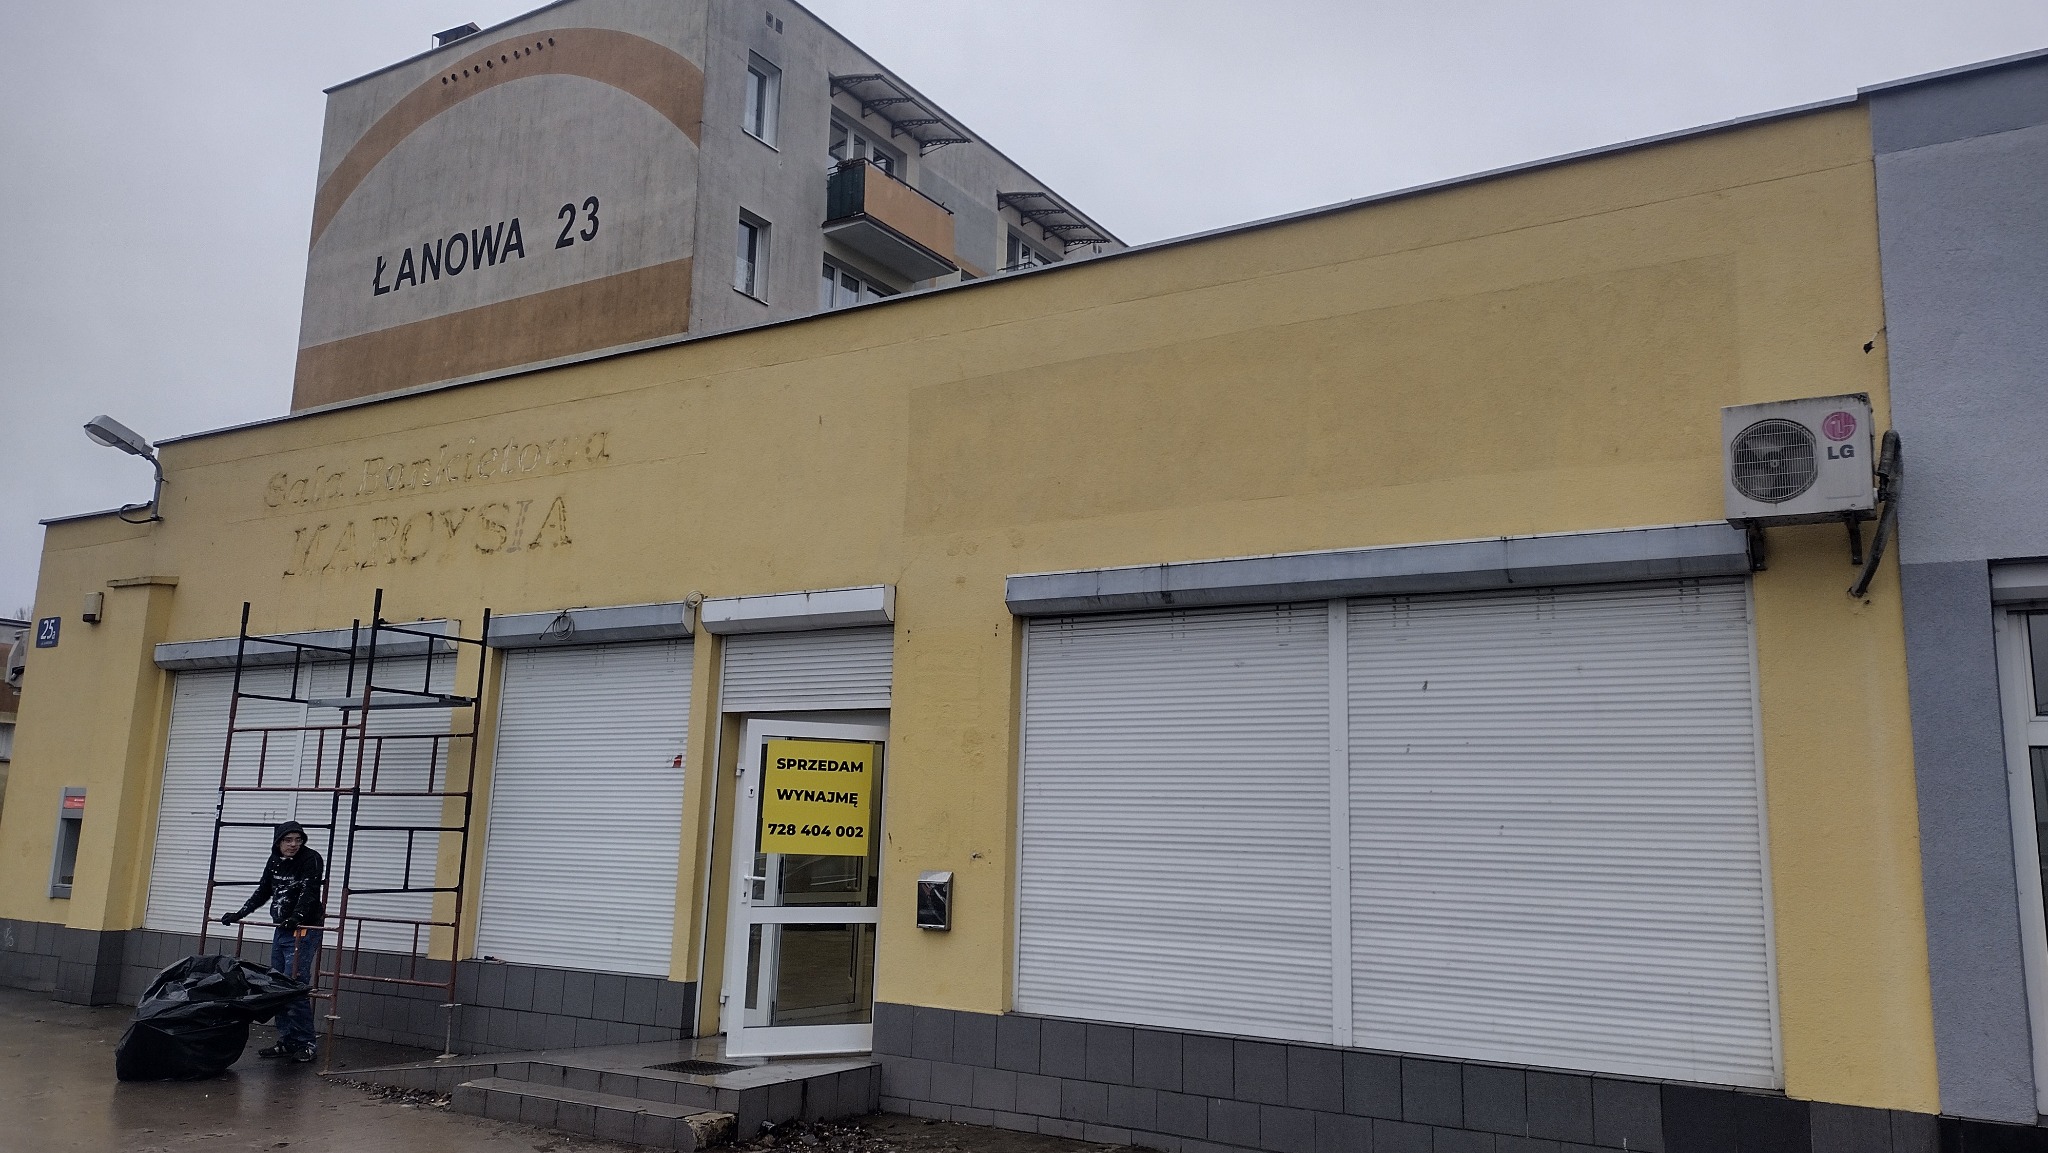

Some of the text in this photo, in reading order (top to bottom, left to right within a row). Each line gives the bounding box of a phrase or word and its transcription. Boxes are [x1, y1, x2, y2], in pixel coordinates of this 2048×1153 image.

[372, 196, 600, 297] ŁANOWA 23
[1827, 444, 1855, 460] LG
[264, 465, 345, 508] Sala
[281, 495, 573, 578] MARCYSIA
[776, 757, 864, 773] SPRZEDAM
[776, 788, 859, 808] WYNAJMĘ
[767, 823, 864, 838] 728 404 002
